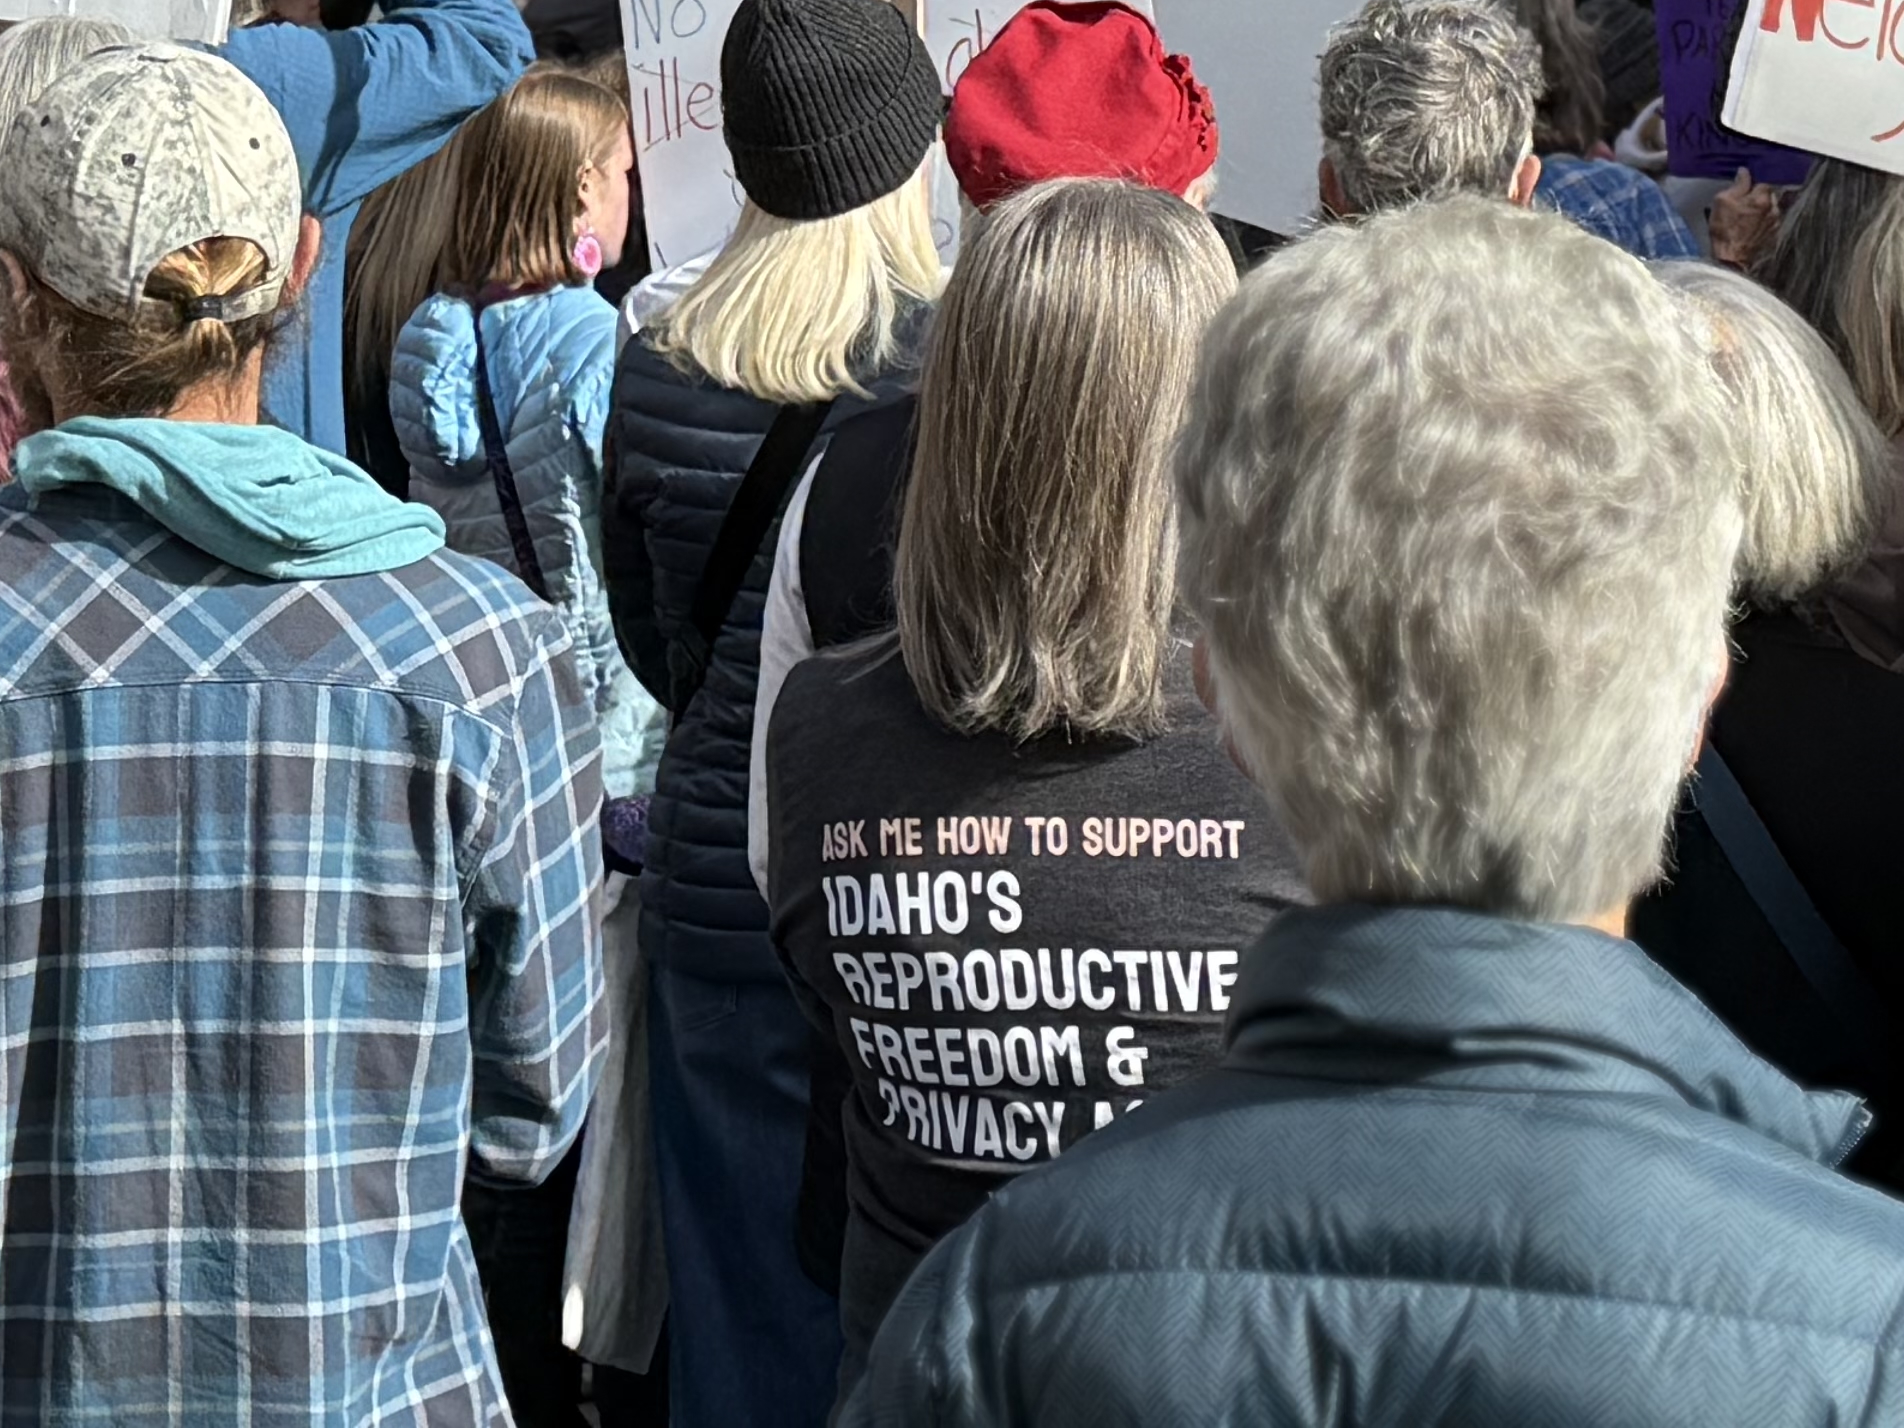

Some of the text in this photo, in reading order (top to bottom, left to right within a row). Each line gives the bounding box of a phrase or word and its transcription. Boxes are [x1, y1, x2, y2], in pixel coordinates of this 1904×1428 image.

[822, 816, 1245, 863] ASK ME HOW TO SUPPORT
[822, 869, 1023, 937] IDAHO'S
[832, 948, 1239, 1013] REPRODUCTIVE
[849, 1016, 1149, 1088] FREEDOM &
[877, 1077, 1066, 1162] PRIVACY
